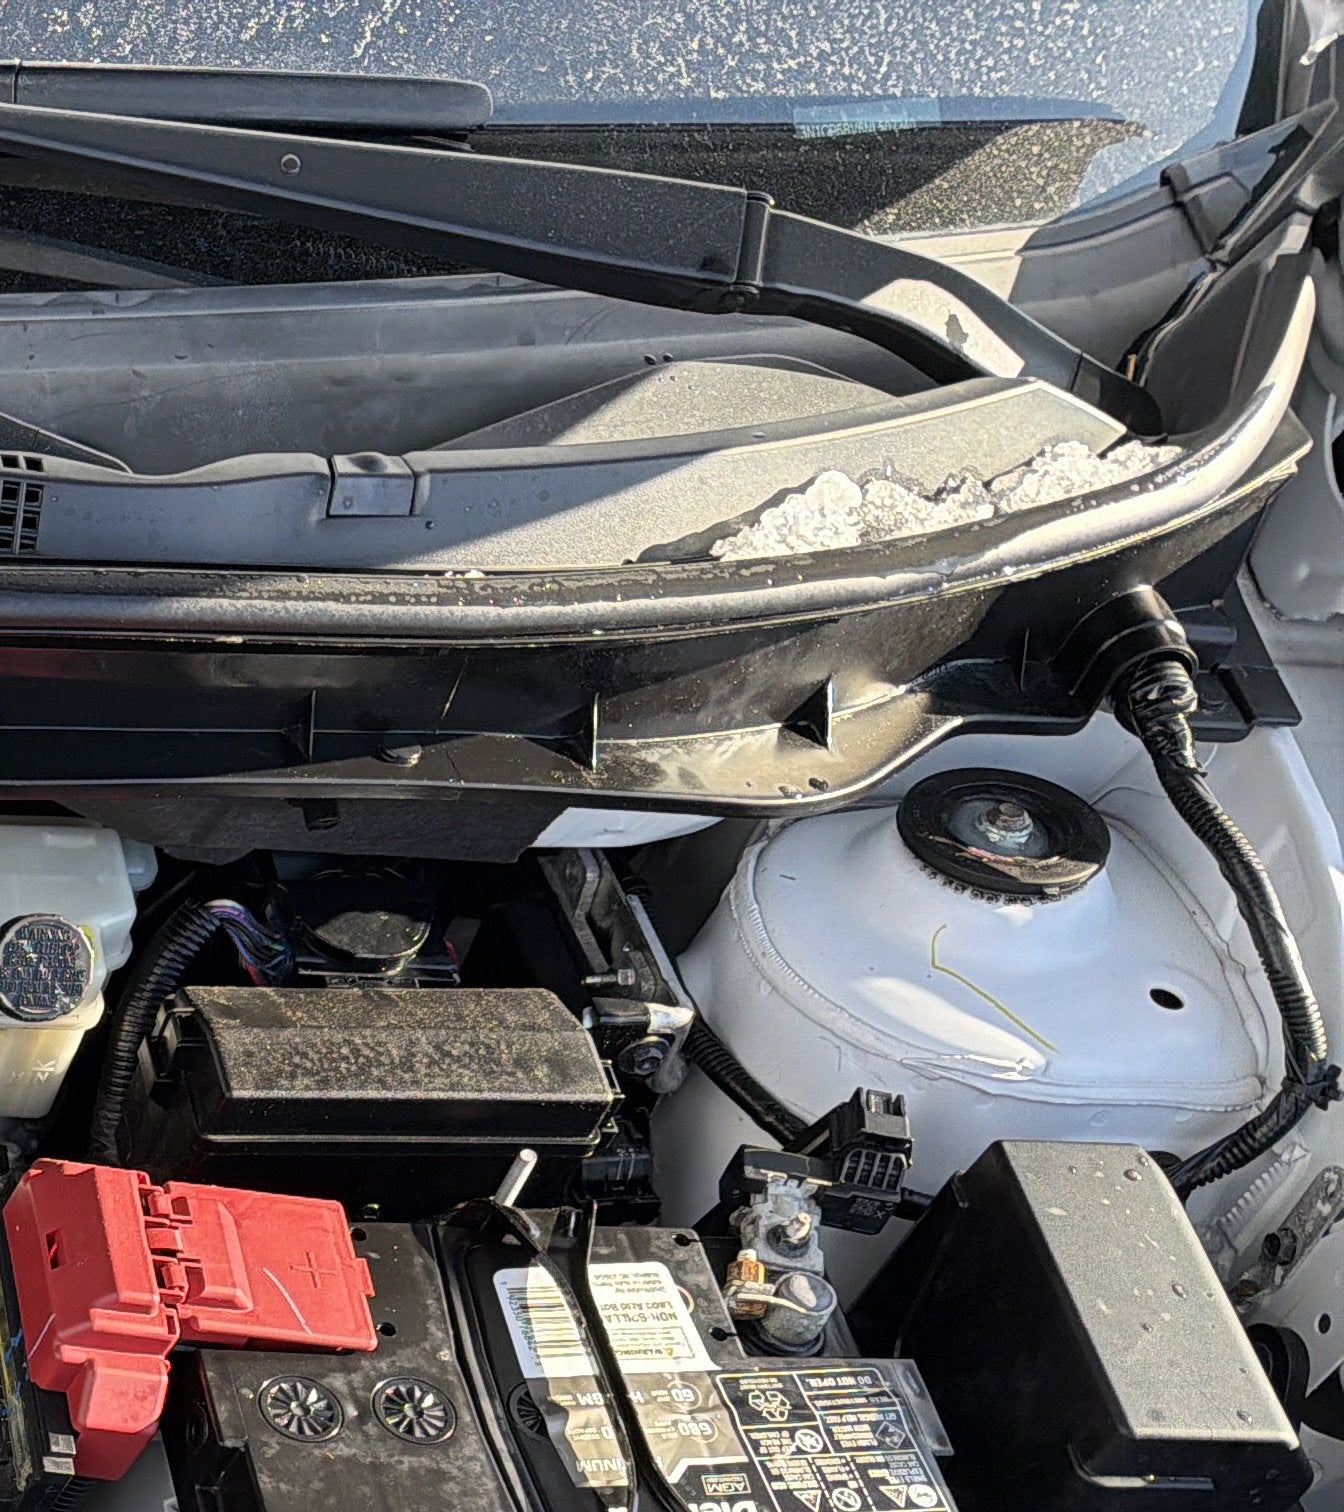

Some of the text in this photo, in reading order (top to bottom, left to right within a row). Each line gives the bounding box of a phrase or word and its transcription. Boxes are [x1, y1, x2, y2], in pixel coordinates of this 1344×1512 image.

[836, 1376, 855, 1386] NOT
[670, 1389, 696, 1402] 60
[677, 1422, 713, 1436] 680
[705, 1482, 747, 1493] AGM
